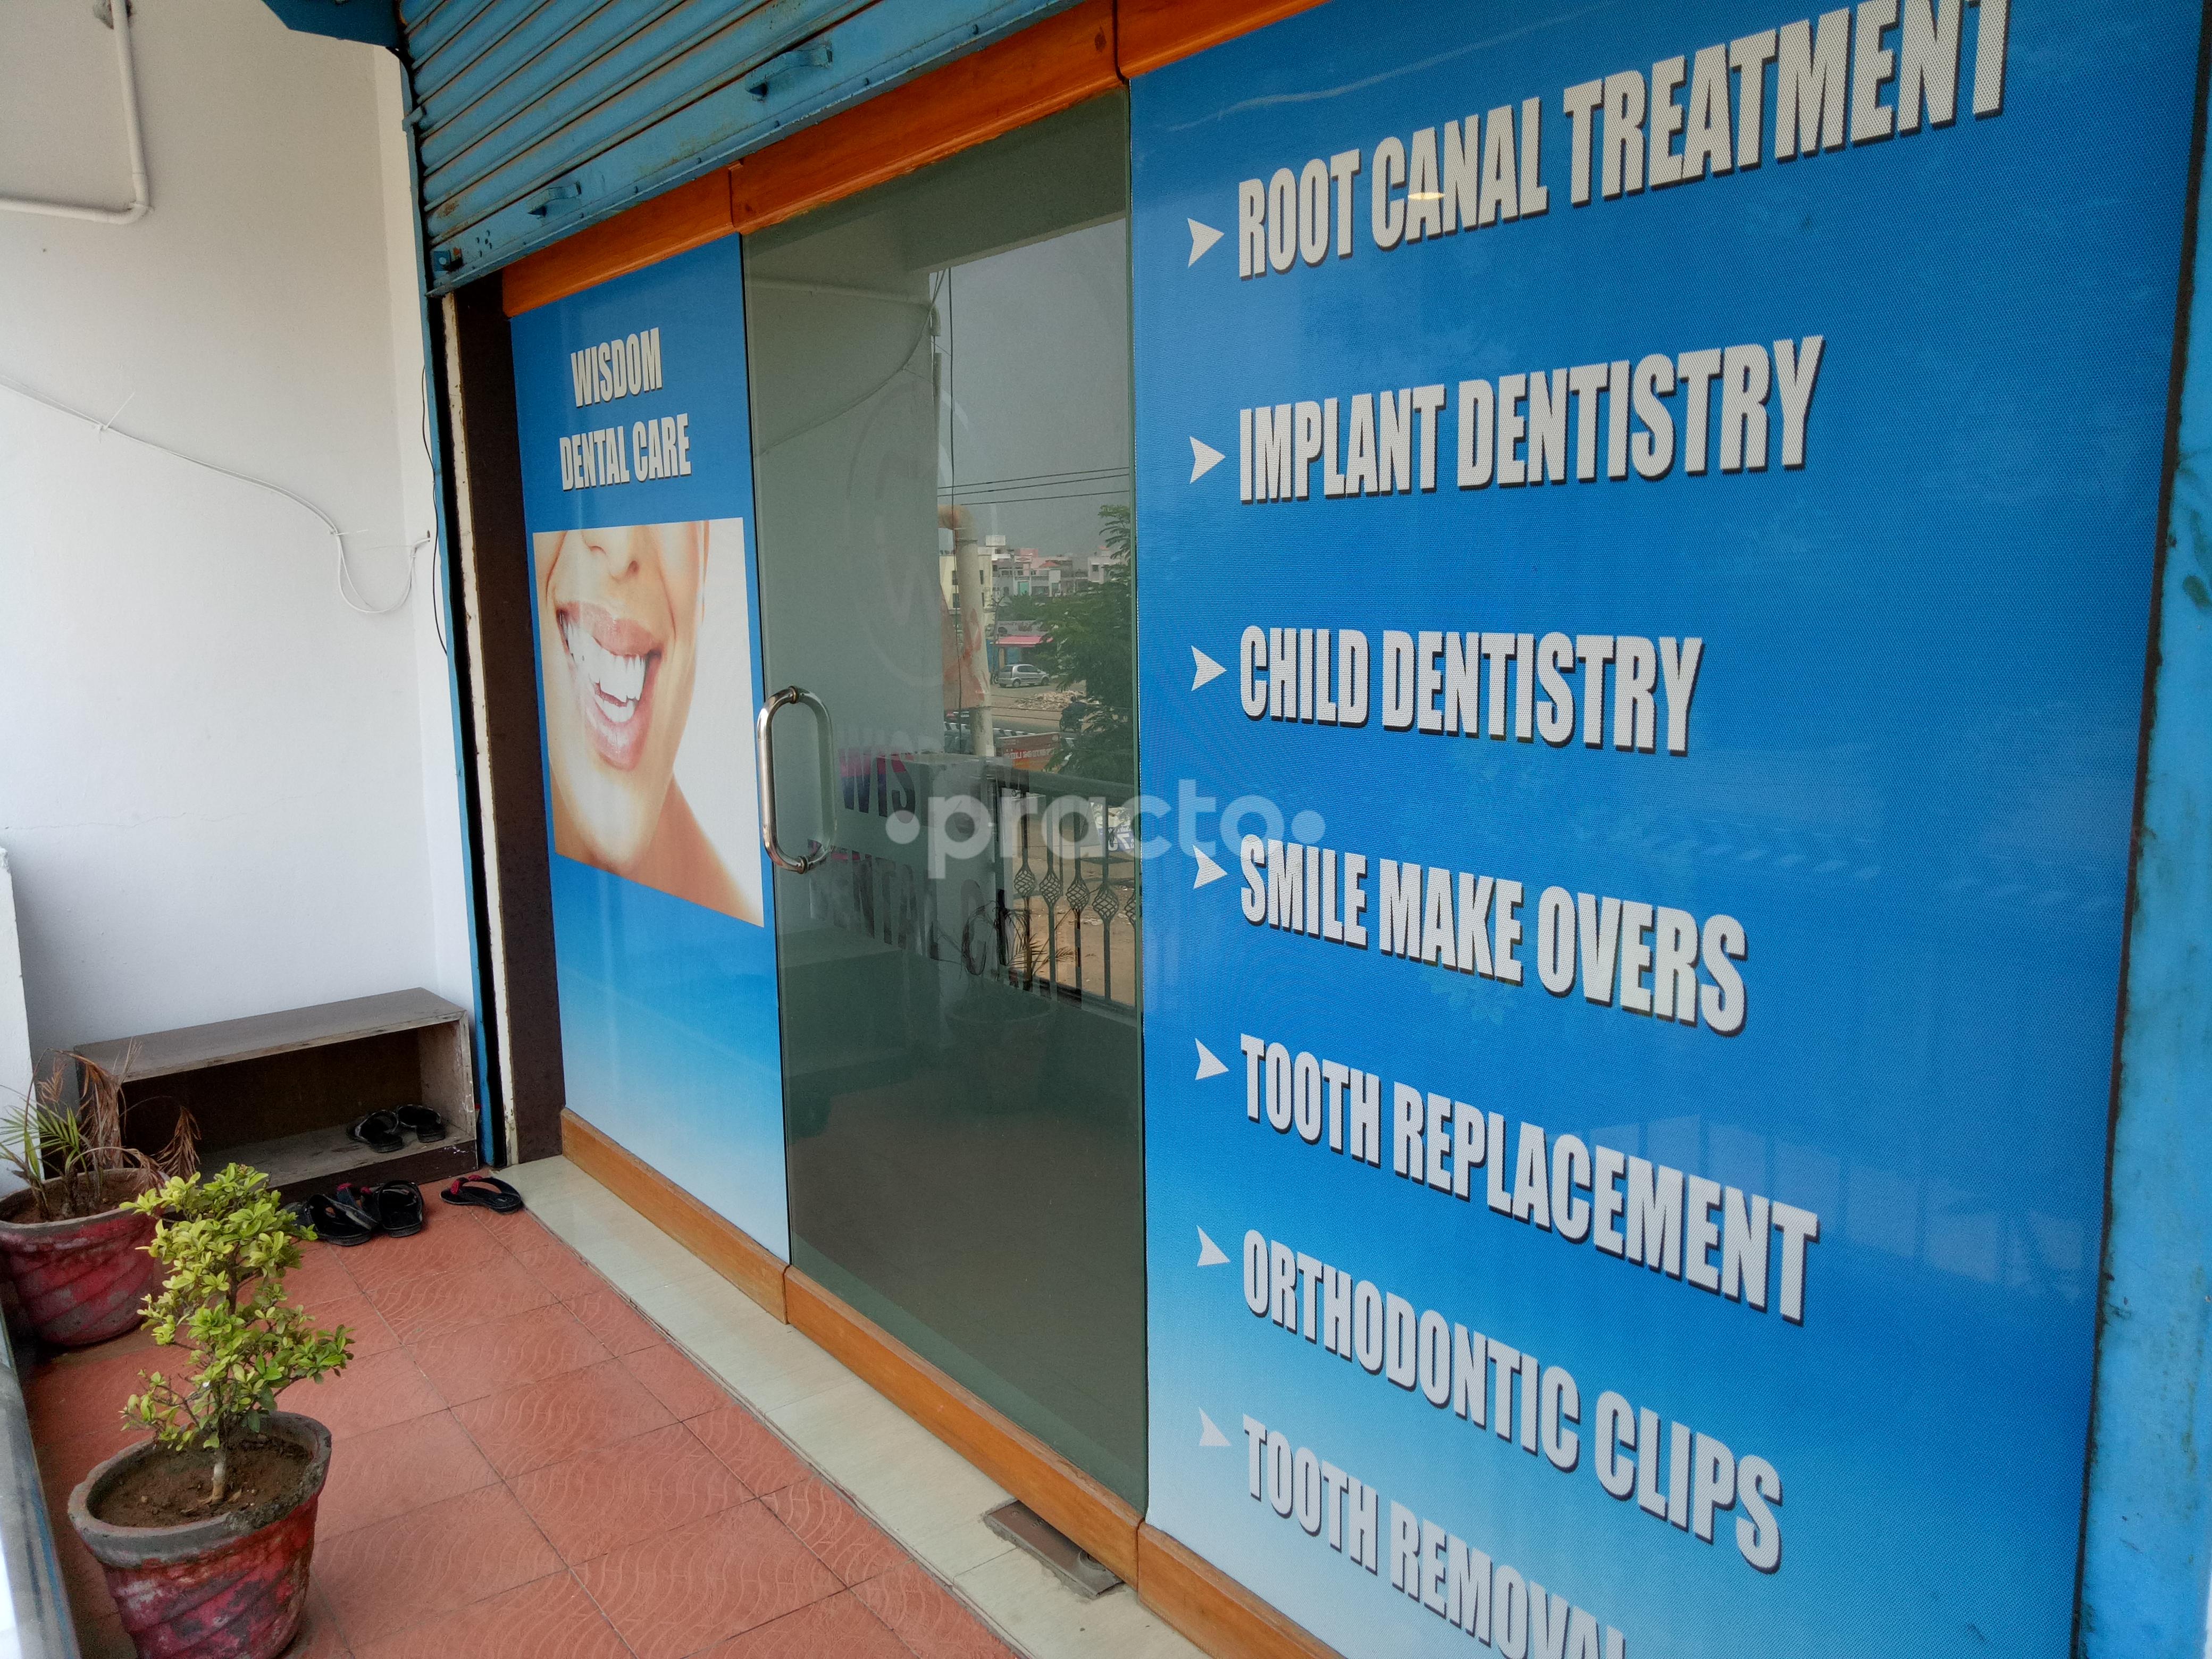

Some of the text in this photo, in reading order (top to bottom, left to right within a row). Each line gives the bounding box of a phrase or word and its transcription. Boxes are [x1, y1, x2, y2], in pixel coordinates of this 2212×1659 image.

[1238, 0, 2011, 280] ROOT CANAL TREATMENT
[559, 413, 691, 491] DENTAL CARE
[571, 328, 663, 407] WISDOM
[1239, 335, 1826, 505] IMPLANT DENTISTRY
[1240, 625, 1704, 757] CHILD DENTISTRY
[1241, 834, 1748, 1036] SMILE MAKE OVERS
[1241, 1034, 1820, 1326] TOOTH REPLACEMENT
[1243, 1229, 1784, 1574] ORTHODONTIC CLIPS
[1243, 1413, 1626, 1659] TOOTH REMOVA
